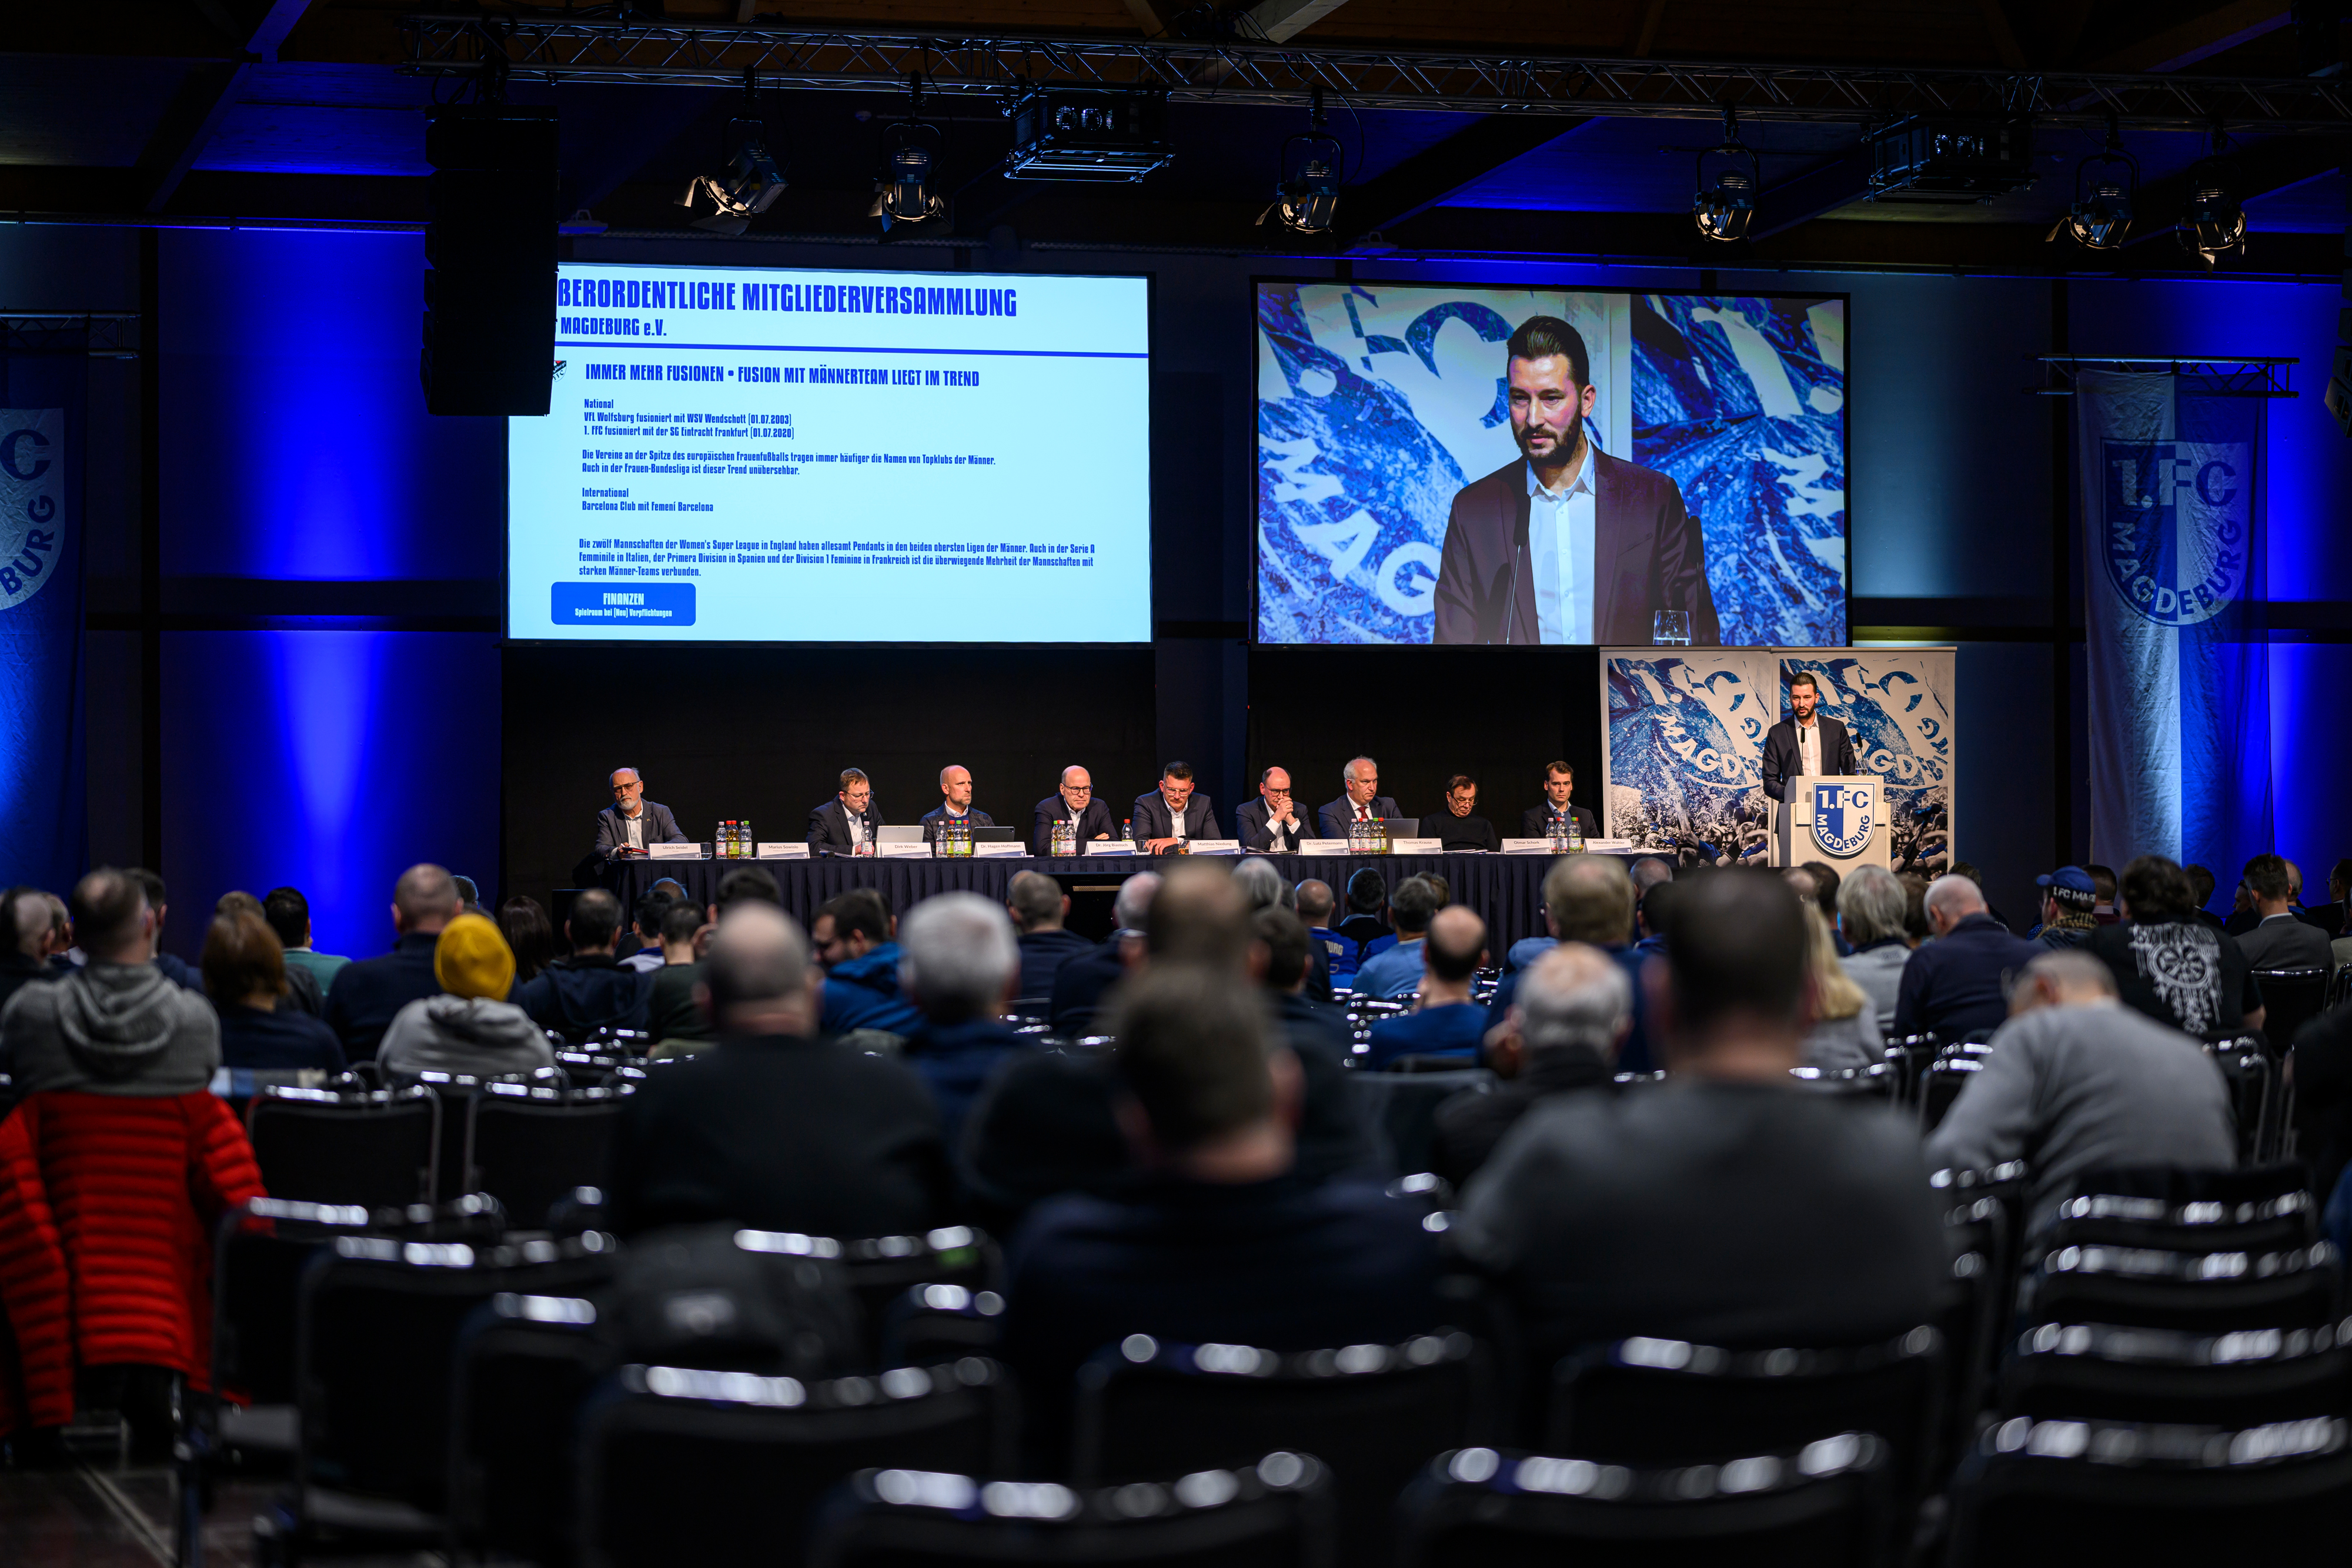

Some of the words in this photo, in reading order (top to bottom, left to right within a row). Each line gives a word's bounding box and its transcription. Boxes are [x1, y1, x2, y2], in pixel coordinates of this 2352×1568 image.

[558, 278, 736, 310] ßERORDENTLICHE
[743, 283, 1017, 316] MITGLIEDERVERSAMMLUNG
[561, 317, 640, 336] MAGDEBURG
[644, 319, 667, 336] e.V.
[586, 363, 626, 380] IMMER
[630, 365, 663, 380] MEHR
[667, 365, 724, 382] FUSIONEN
[738, 366, 780, 383] FUSION
[784, 367, 806, 383] MIT
[809, 364, 888, 385] MÄNNERTEAM
[892, 369, 921, 386] LIEGT
[925, 370, 940, 386] IM
[943, 370, 979, 386] TREND
[584, 399, 614, 409] National
[597, 412, 634, 424] Wolfsburg
[636, 412, 672, 423] fusioniert
[674, 413, 685, 423] mit
[687, 413, 703, 423] WSV
[704, 413, 746, 424] Wendschott
[584, 425, 590, 435] 1.
[592, 425, 603, 435] FFC
[604, 426, 640, 436] fusioniert
[642, 426, 654, 436] mit
[656, 426, 669, 436] der
[670, 426, 679, 436] SG
[681, 426, 713, 437] Eintracht
[715, 427, 749, 437] Frankfurt
[582, 449, 594, 459] Die
[595, 449, 623, 460] Vereine
[624, 452, 633, 460] an
[635, 450, 647, 460] der
[649, 450, 671, 462] Spitze
[673, 450, 685, 460] des
[687, 451, 734, 462] europäischen
[736, 451, 789, 462] Frauenfußballs
[790, 452, 814, 464] tragen
[816, 452, 838, 462] immer
[840, 453, 870, 464] häufiger
[871, 453, 882, 463] die
[884, 453, 907, 463] Namen
[908, 456, 921, 464] von
[922, 454, 953, 466] Topklubs
[954, 454, 967, 464] der
[968, 455, 995, 465] Männer.
[582, 463, 600, 473] Auch
[602, 463, 609, 473] in
[610, 463, 623, 473] der
[624, 463, 690, 475] Frauen-Bundesliga
[691, 464, 701, 474] ist
[703, 464, 726, 474] dieser
[727, 464, 747, 474] Trend
[749, 464, 800, 475] unübersehbar.
[2112, 459, 2237, 508] 1.FC
[582, 487, 629, 497] International
[582, 500, 618, 511] Barcelona
[620, 501, 636, 511] Club
[637, 501, 650, 511] mit
[651, 502, 676, 511] Femení
[678, 502, 713, 511] Barcelona
[1258, 434, 1441, 616] MAG
[0, 494, 56, 596] BURG
[579, 539, 590, 549] Die
[592, 539, 612, 549] zwölf
[614, 539, 663, 549] Mannschaften
[665, 539, 678, 549] der
[679, 539, 711, 549] Women's
[713, 540, 734, 551] Super
[736, 540, 760, 551] League
[761, 540, 768, 550] in
[770, 540, 797, 552] England
[799, 540, 820, 550] haben
[821, 541, 851, 551] allesamt
[853, 541, 885, 551] Pendants
[887, 541, 893, 551] in
[895, 541, 908, 551] den
[909, 541, 933, 551] beiden
[934, 542, 965, 552] obersten
[967, 542, 985, 554] Ligen
[986, 543, 998, 553] der
[1000, 543, 1028, 553] Männer.
[1030, 543, 1047, 553] Auch
[1048, 543, 1055, 553] in
[1056, 543, 1068, 553] der
[1070, 544, 1088, 554] Serie
[1090, 544, 1095, 554] A
[579, 551, 615, 562] Femminile
[617, 552, 624, 562] in
[626, 552, 651, 563] Italien,
[653, 552, 666, 562] der
[667, 553, 696, 563] Primera
[699, 553, 727, 563] Division
[729, 553, 736, 563] in
[737, 553, 766, 565] Spanien
[767, 553, 780, 563] und
[782, 553, 794, 563] der
[796, 554, 824, 564] Division
[826, 554, 829, 564] 1
[831, 554, 861, 564] Feminine
[863, 554, 870, 564] in
[872, 554, 910, 564] Frankreich
[911, 555, 921, 565] ist
[923, 555, 933, 565] die
[935, 555, 984, 567] überwiegende
[985, 556, 1017, 566] Mehrheit
[1018, 556, 1031, 566] der
[1033, 556, 1080, 567] Mannschaften
[1082, 557, 1094, 567] mit
[579, 566, 607, 576] starken
[609, 566, 660, 576] Männer-Teams
[662, 566, 701, 576] verbunden.
[2111, 519, 2242, 616] MAGDEBURG
[603, 593, 644, 606] FINANZEN
[574, 608, 603, 617] Spielraum
[604, 608, 613, 616] bei
[613, 607, 629, 618] (Neu)
[629, 609, 673, 618] Verpflichtungen
[1818, 790, 1869, 810] 1.FC
[1817, 814, 1870, 850] MAGDEBURG
